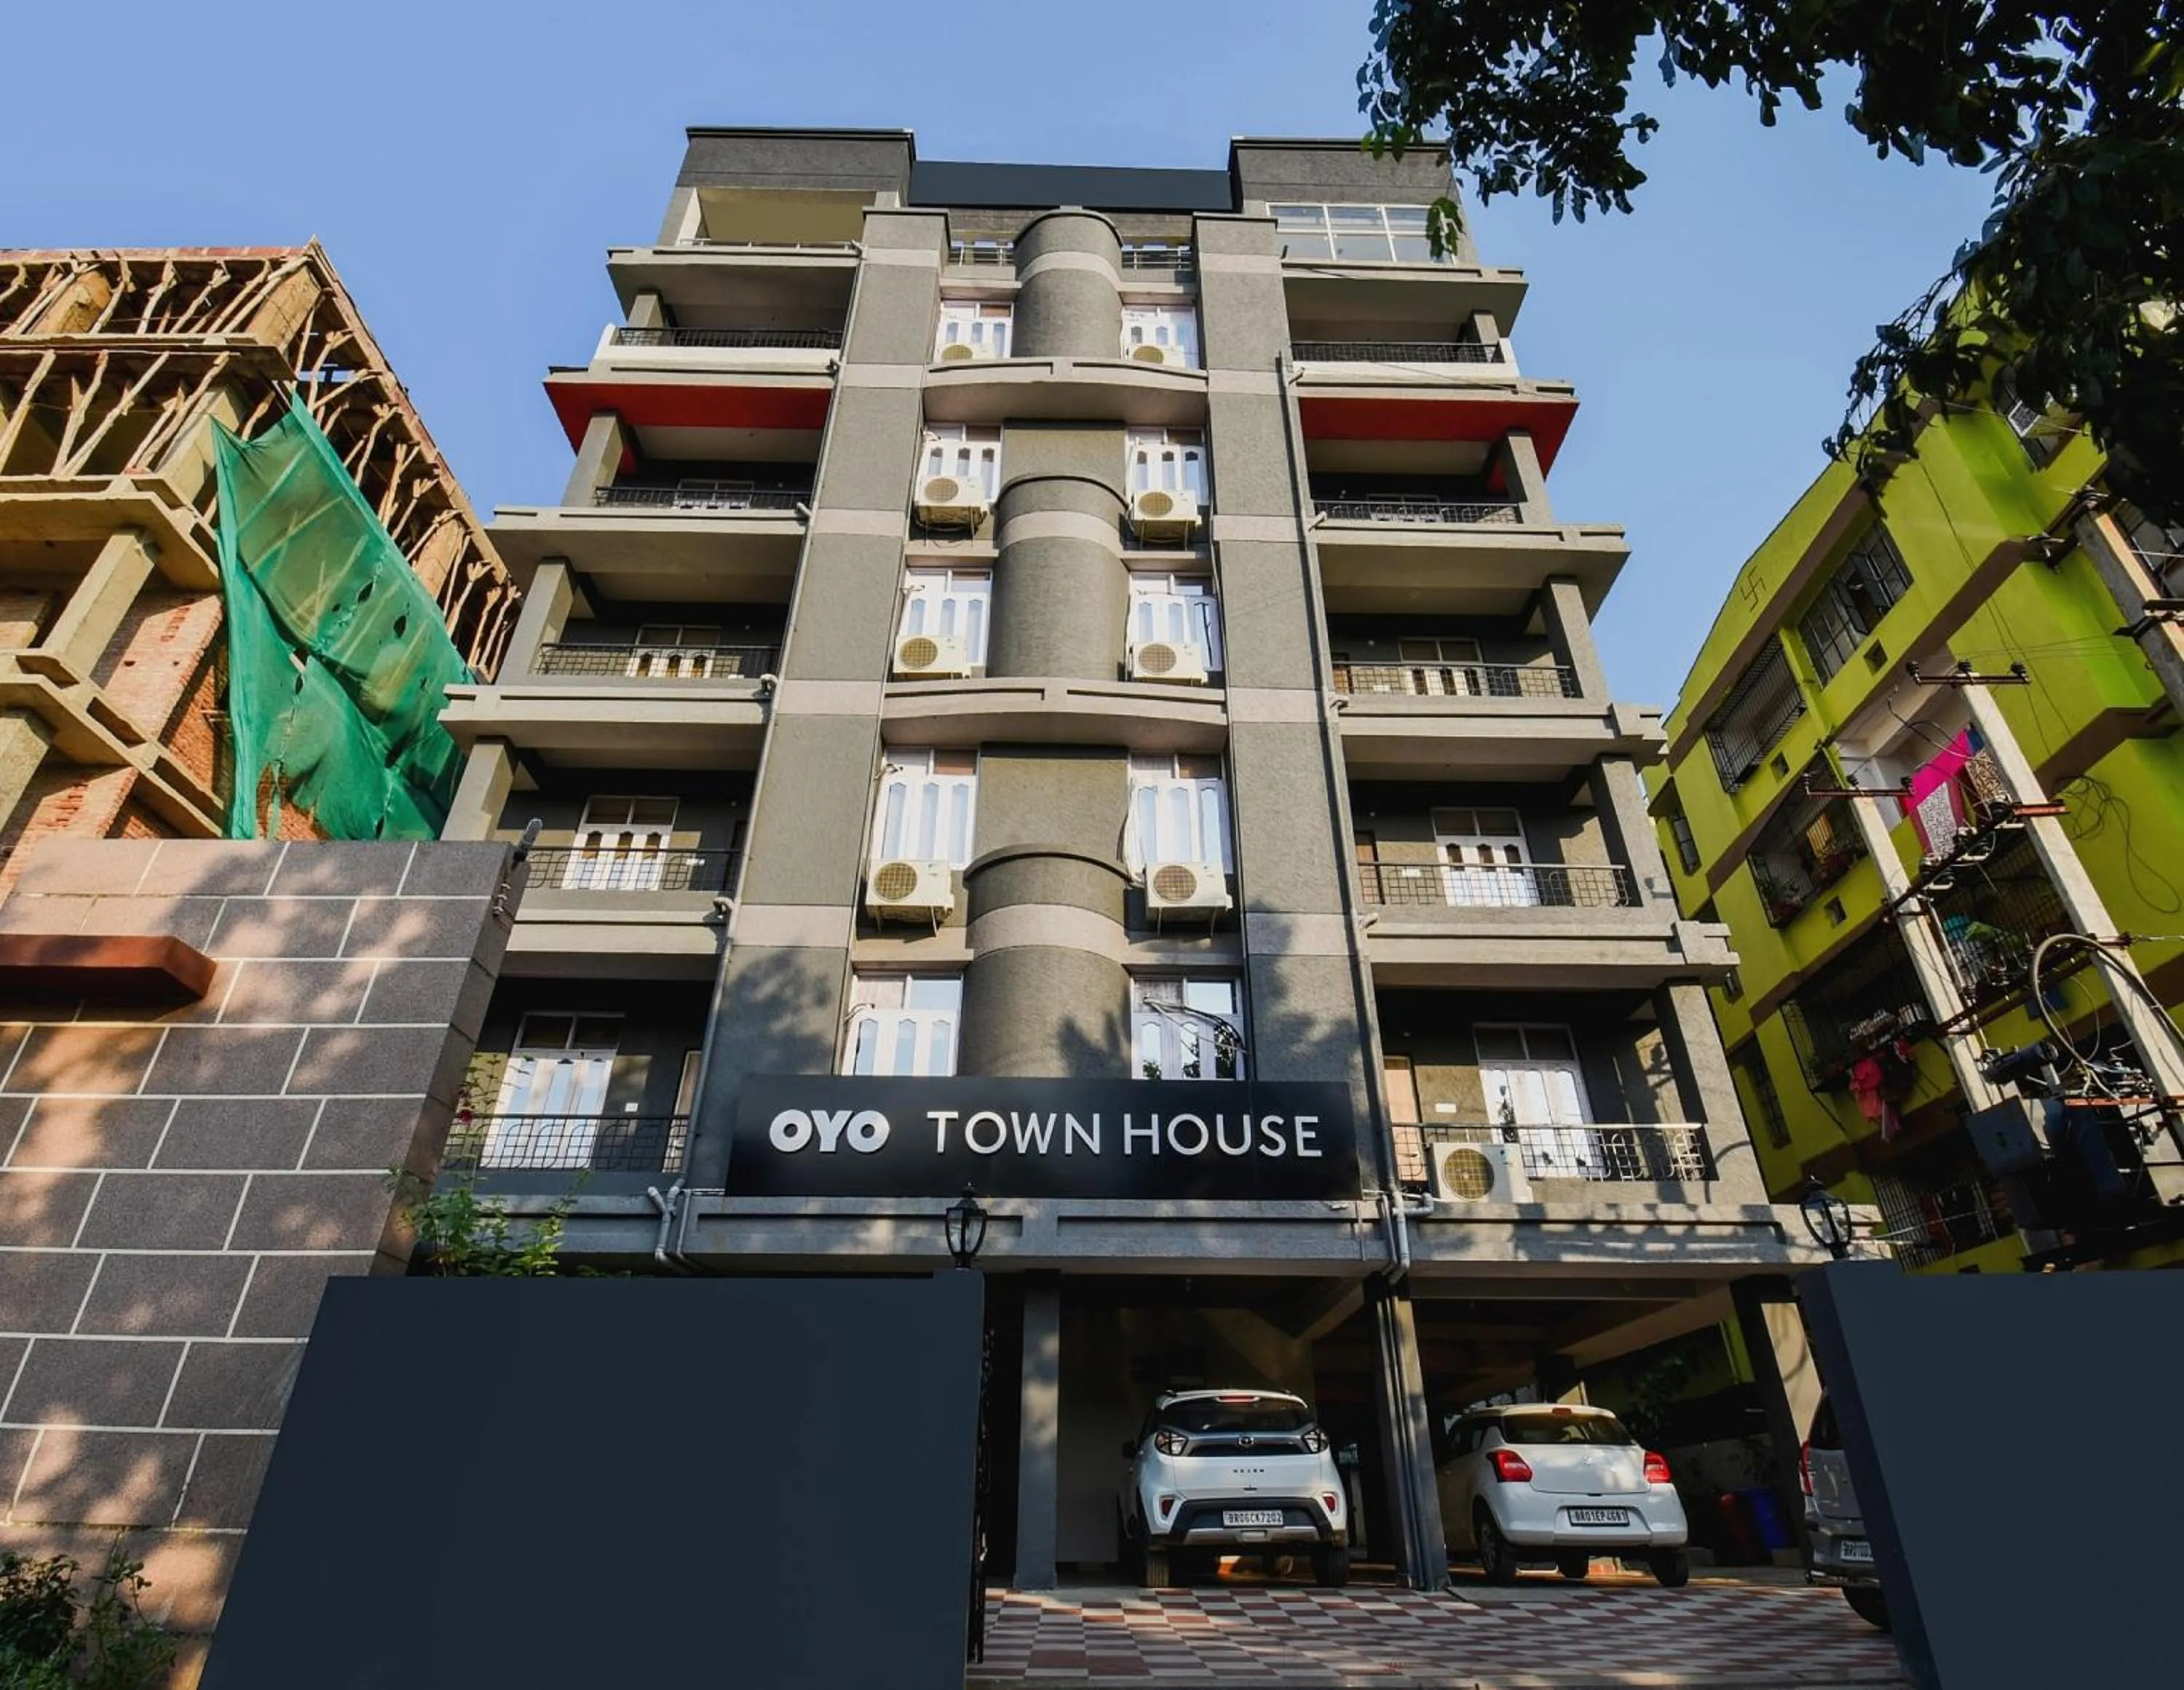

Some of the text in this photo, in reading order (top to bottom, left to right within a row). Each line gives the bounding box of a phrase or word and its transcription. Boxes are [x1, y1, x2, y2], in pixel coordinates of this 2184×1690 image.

[769, 1108, 1323, 1157] OYO TOWN HOUSE
